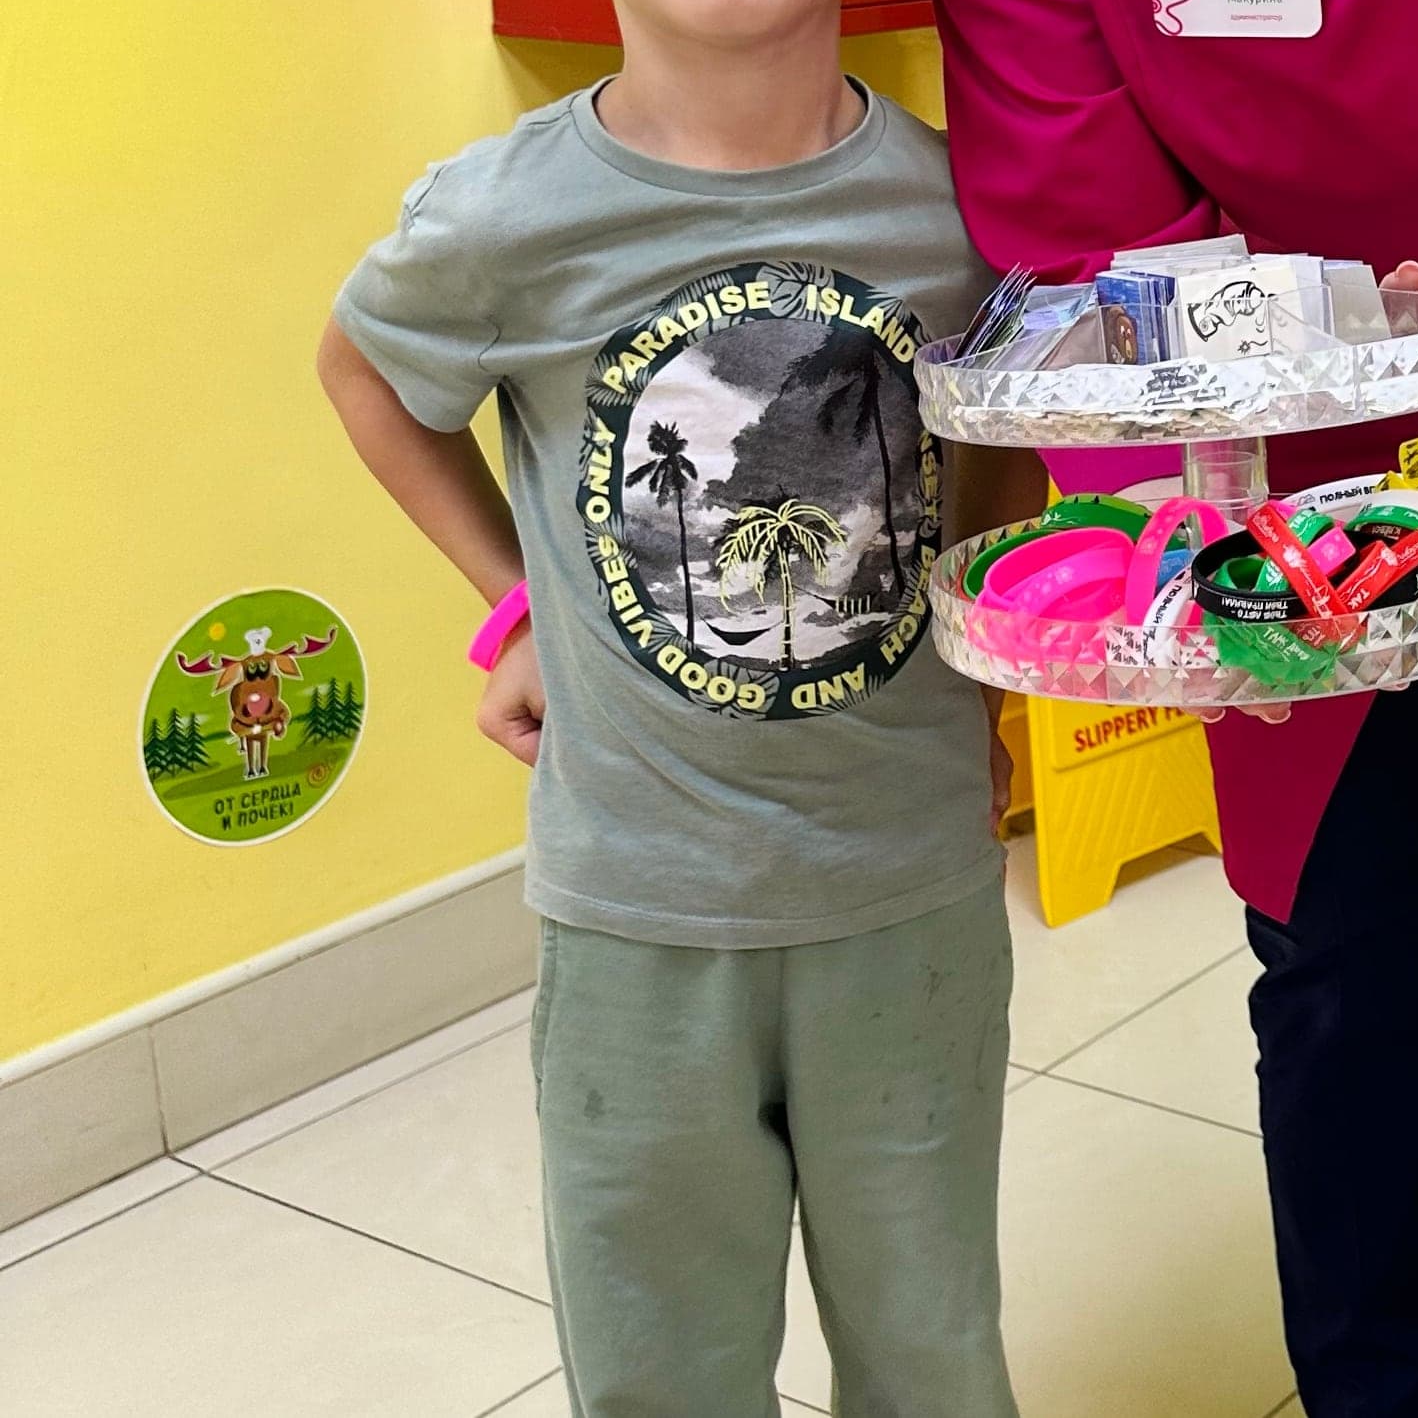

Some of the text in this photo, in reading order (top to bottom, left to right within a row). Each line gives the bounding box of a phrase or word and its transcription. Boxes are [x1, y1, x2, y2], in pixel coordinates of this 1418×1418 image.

[586, 280, 940, 711] PARADISE ISLAND NSET BEACH AND GOOD VIBES ONLY
[1074, 706, 1158, 752] SLIPPERY
[214, 783, 302, 815] ОТ СЕРДЦА
[222, 803, 294, 831] И ПОЧЕК!
